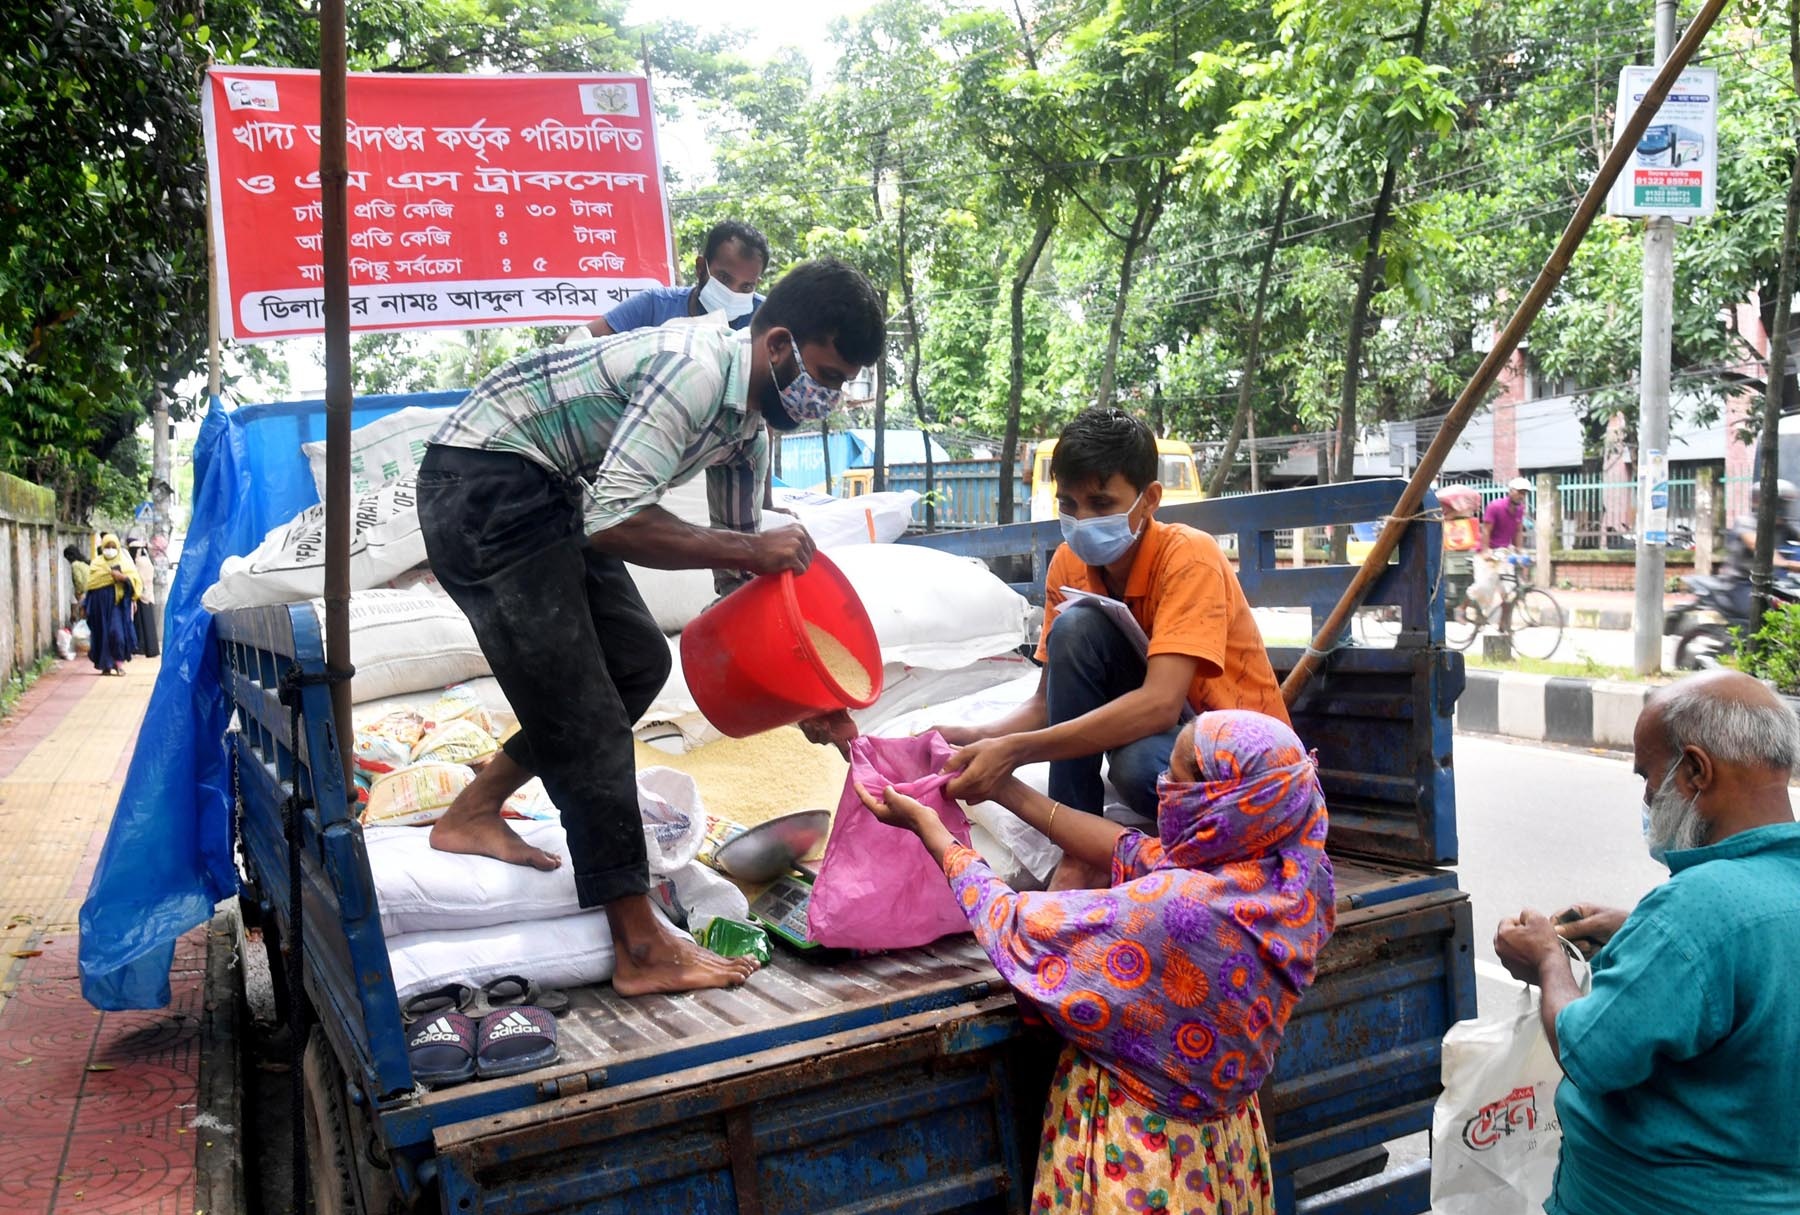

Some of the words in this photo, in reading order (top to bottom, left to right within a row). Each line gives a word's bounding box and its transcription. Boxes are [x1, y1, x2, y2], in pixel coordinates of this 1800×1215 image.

[232, 120, 297, 152] খাদ্য
[432, 117, 512, 163] কর্তৃক
[520, 117, 645, 153] পরিচালিত
[236, 175, 277, 195] ও
[387, 171, 464, 193] এস
[473, 165, 650, 195] ট্রাকসেল
[354, 198, 397, 220] প্রতি
[403, 198, 455, 220] কেজি
[526, 203, 557, 217] ৩০
[569, 197, 614, 219] টাকা
[351, 226, 394, 249] প্রতি
[400, 225, 452, 248] কেজি
[573, 224, 617, 245] টাকা
[532, 256, 548, 272] ৫
[578, 251, 626, 273] কেজি
[446, 287, 525, 313] আব্দুল
[532, 282, 598, 307] করিম
[410, 1031, 461, 1047] adidas
[489, 1023, 542, 1040] adidas
